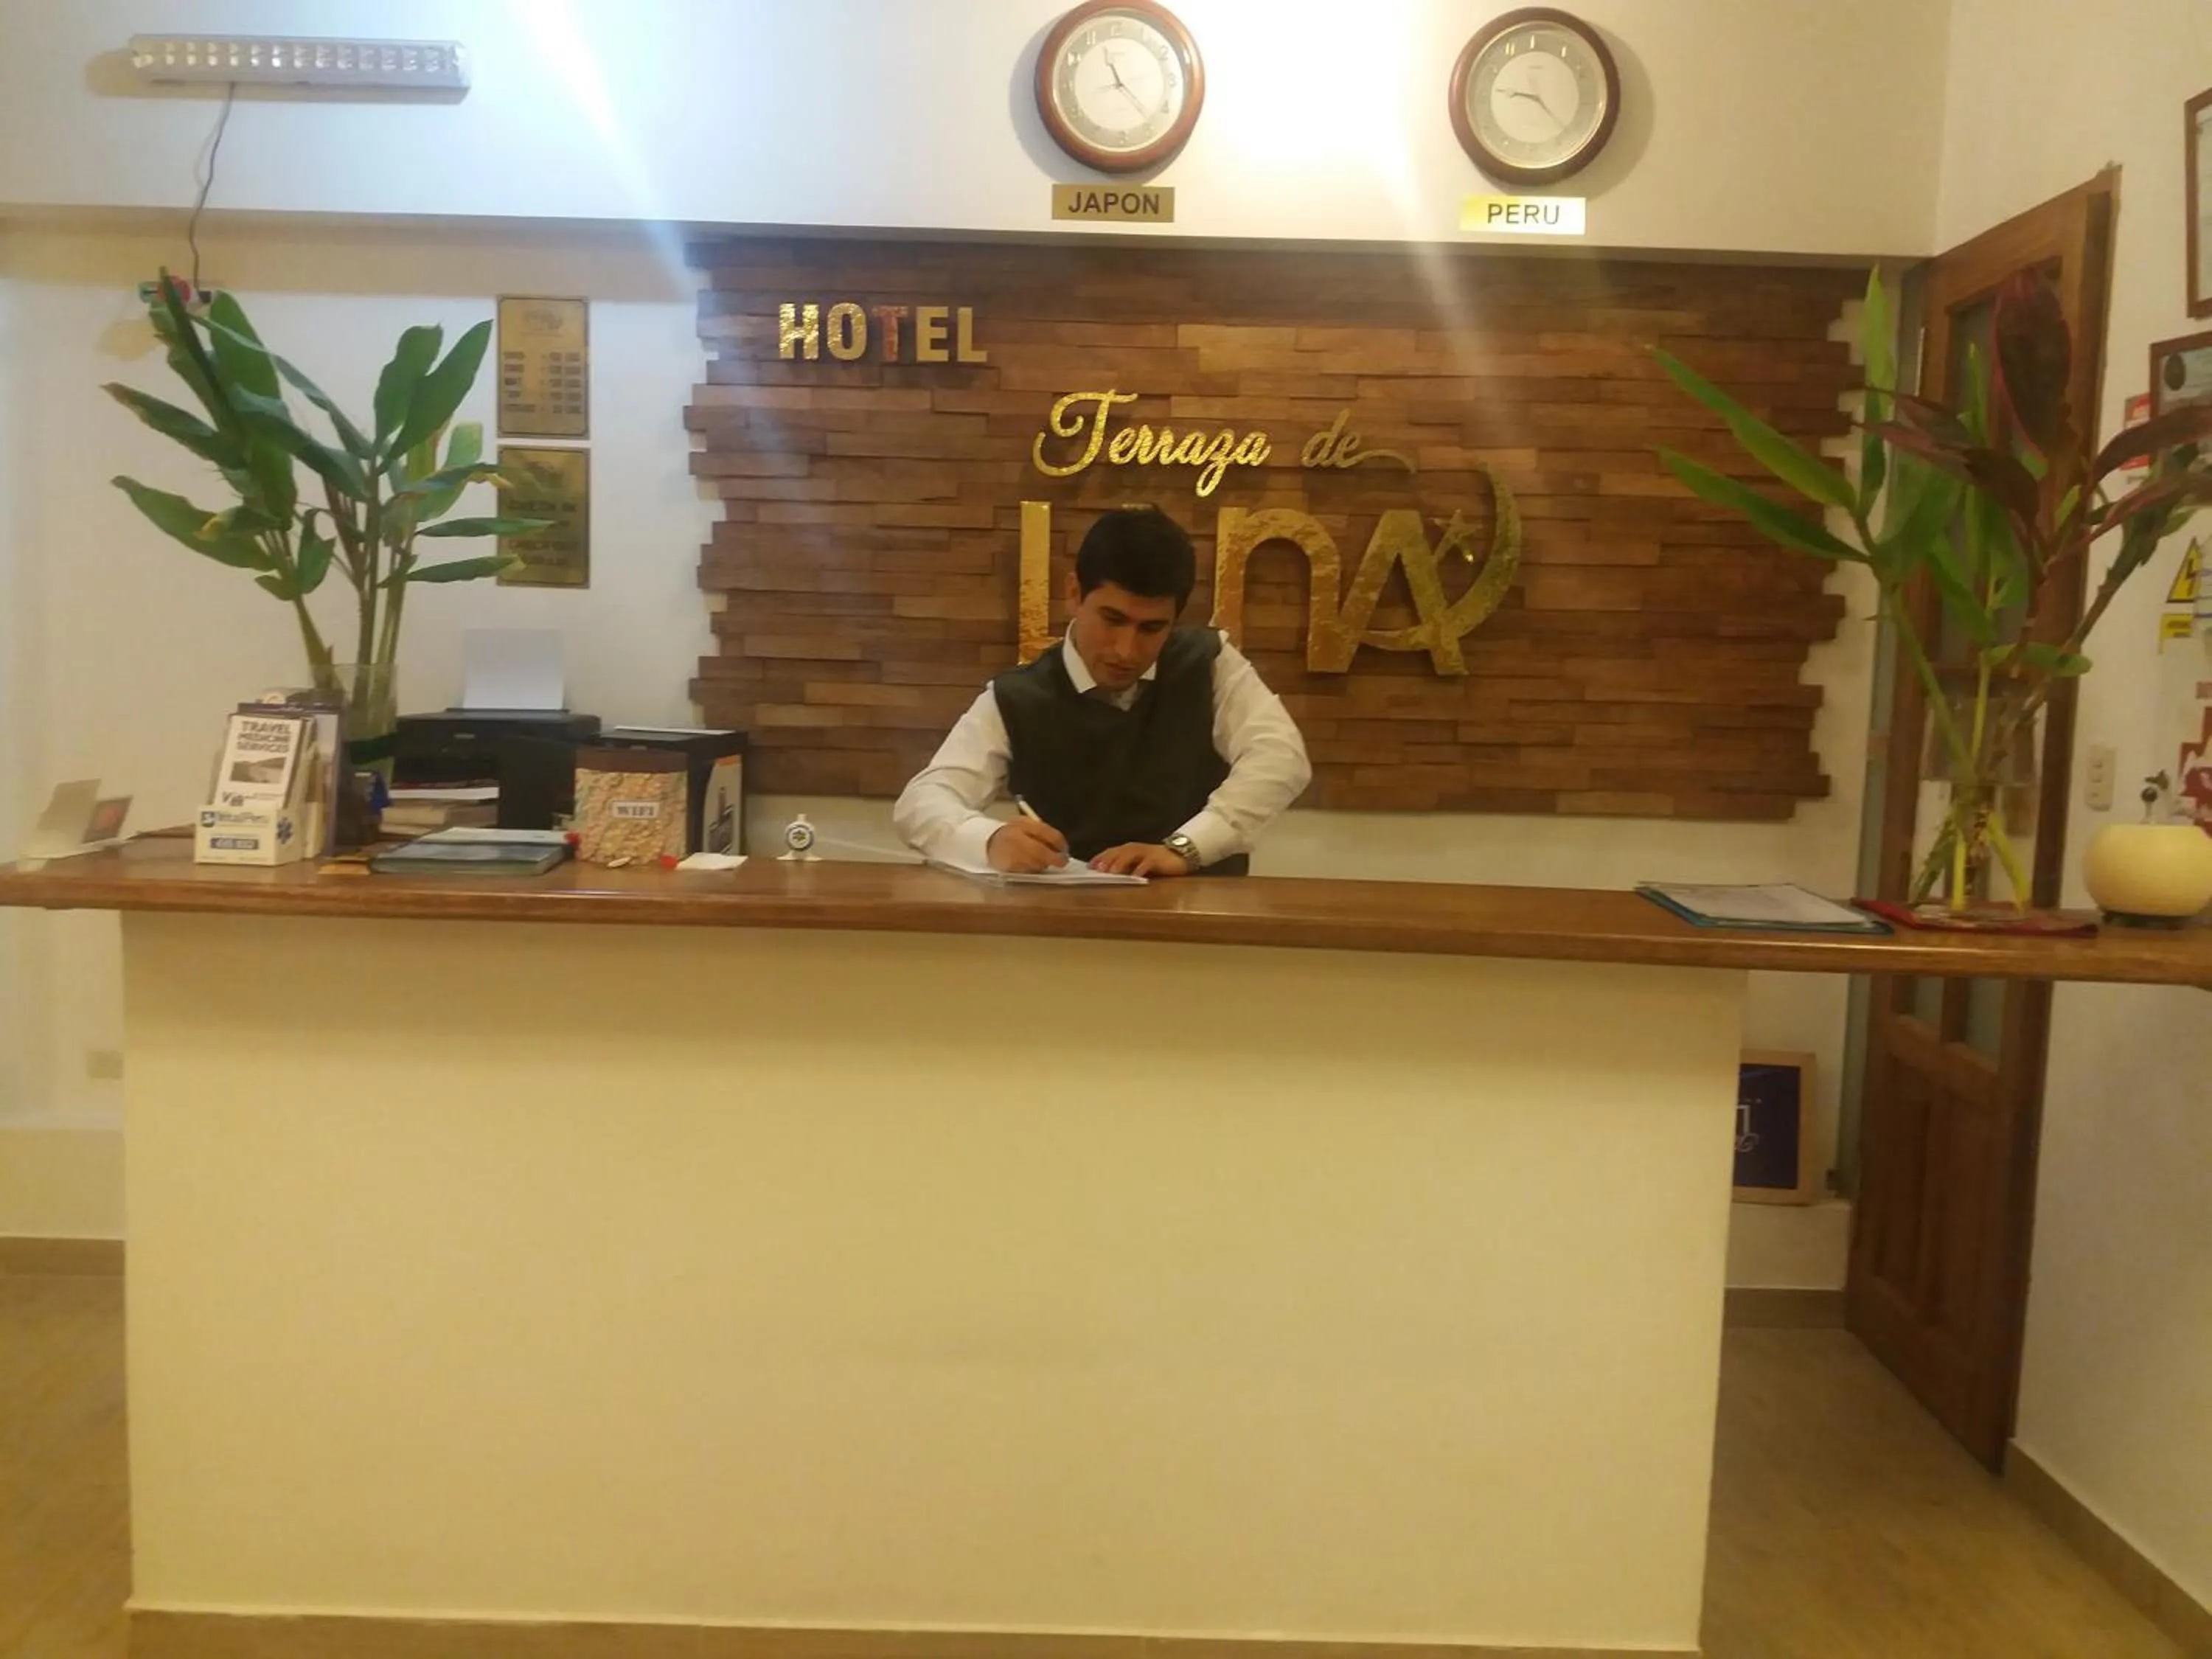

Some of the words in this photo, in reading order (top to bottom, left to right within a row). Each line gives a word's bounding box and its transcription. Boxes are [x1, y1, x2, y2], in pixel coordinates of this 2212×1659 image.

[1068, 192, 1160, 215] JAPON
[1486, 203, 1560, 225] PERU
[779, 302, 988, 362] HOTEL
[1032, 389, 1272, 498] Terraza
[1301, 408, 1416, 474] de
[241, 720, 292, 735] TRAVEL
[617, 806, 655, 816] WIFI
